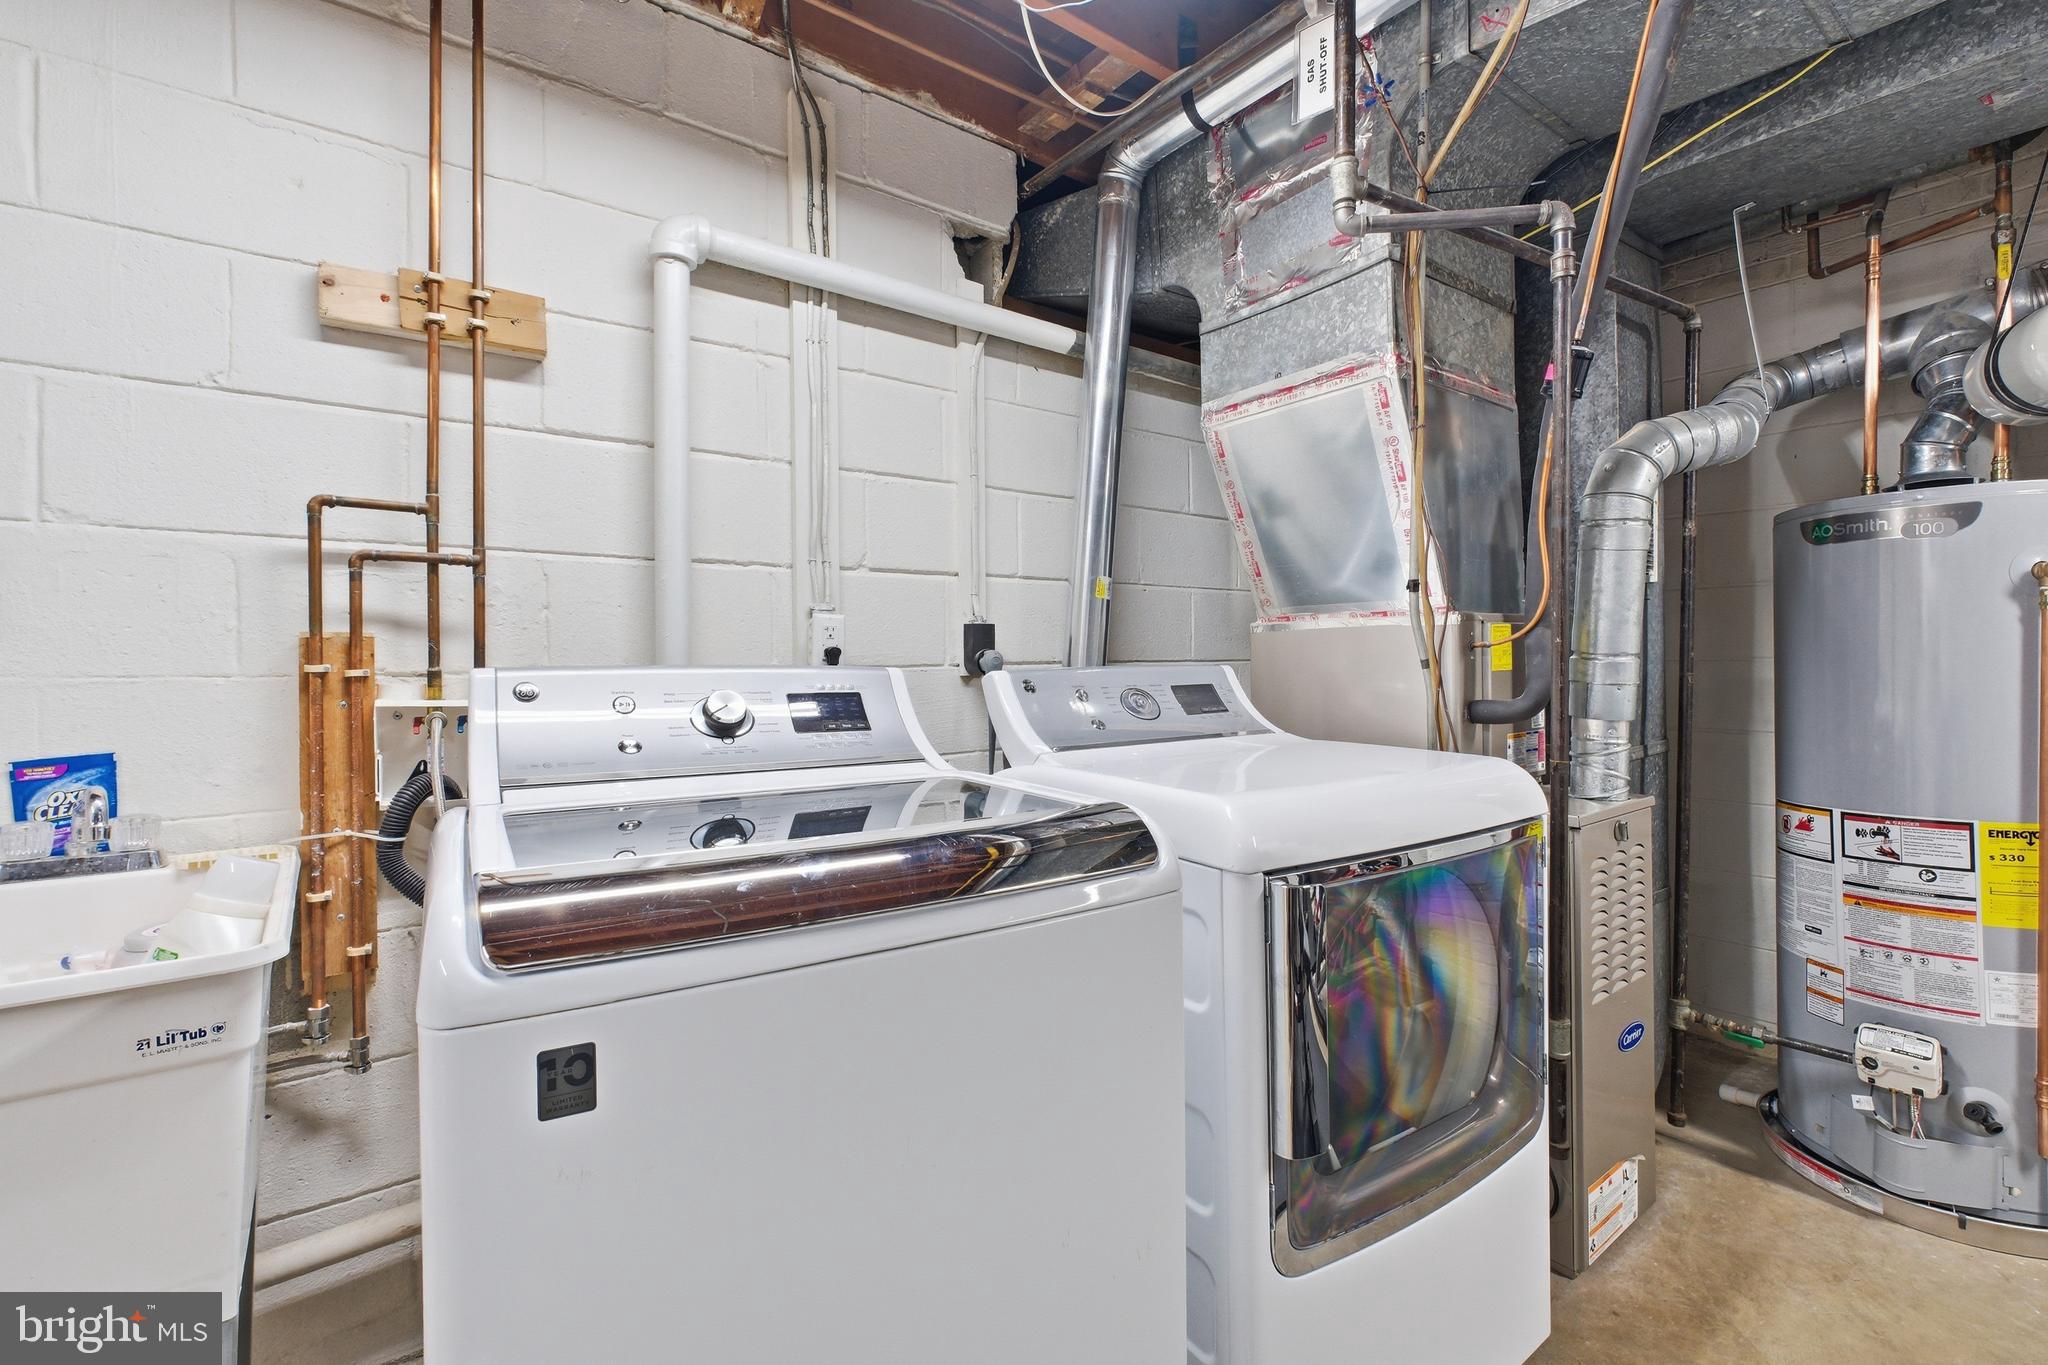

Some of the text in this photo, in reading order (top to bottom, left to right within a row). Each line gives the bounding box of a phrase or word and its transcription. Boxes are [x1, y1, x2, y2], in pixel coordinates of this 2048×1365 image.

[1307, 58, 1315, 83] GAS
[1913, 521, 1944, 536] 100
[47, 789, 87, 808] OX
[2000, 853, 2025, 862] 330
[1623, 1028, 1642, 1046] Carrier
[136, 1040, 150, 1051] 21
[540, 1052, 594, 1091] 10
[547, 1067, 574, 1077] YEAR
